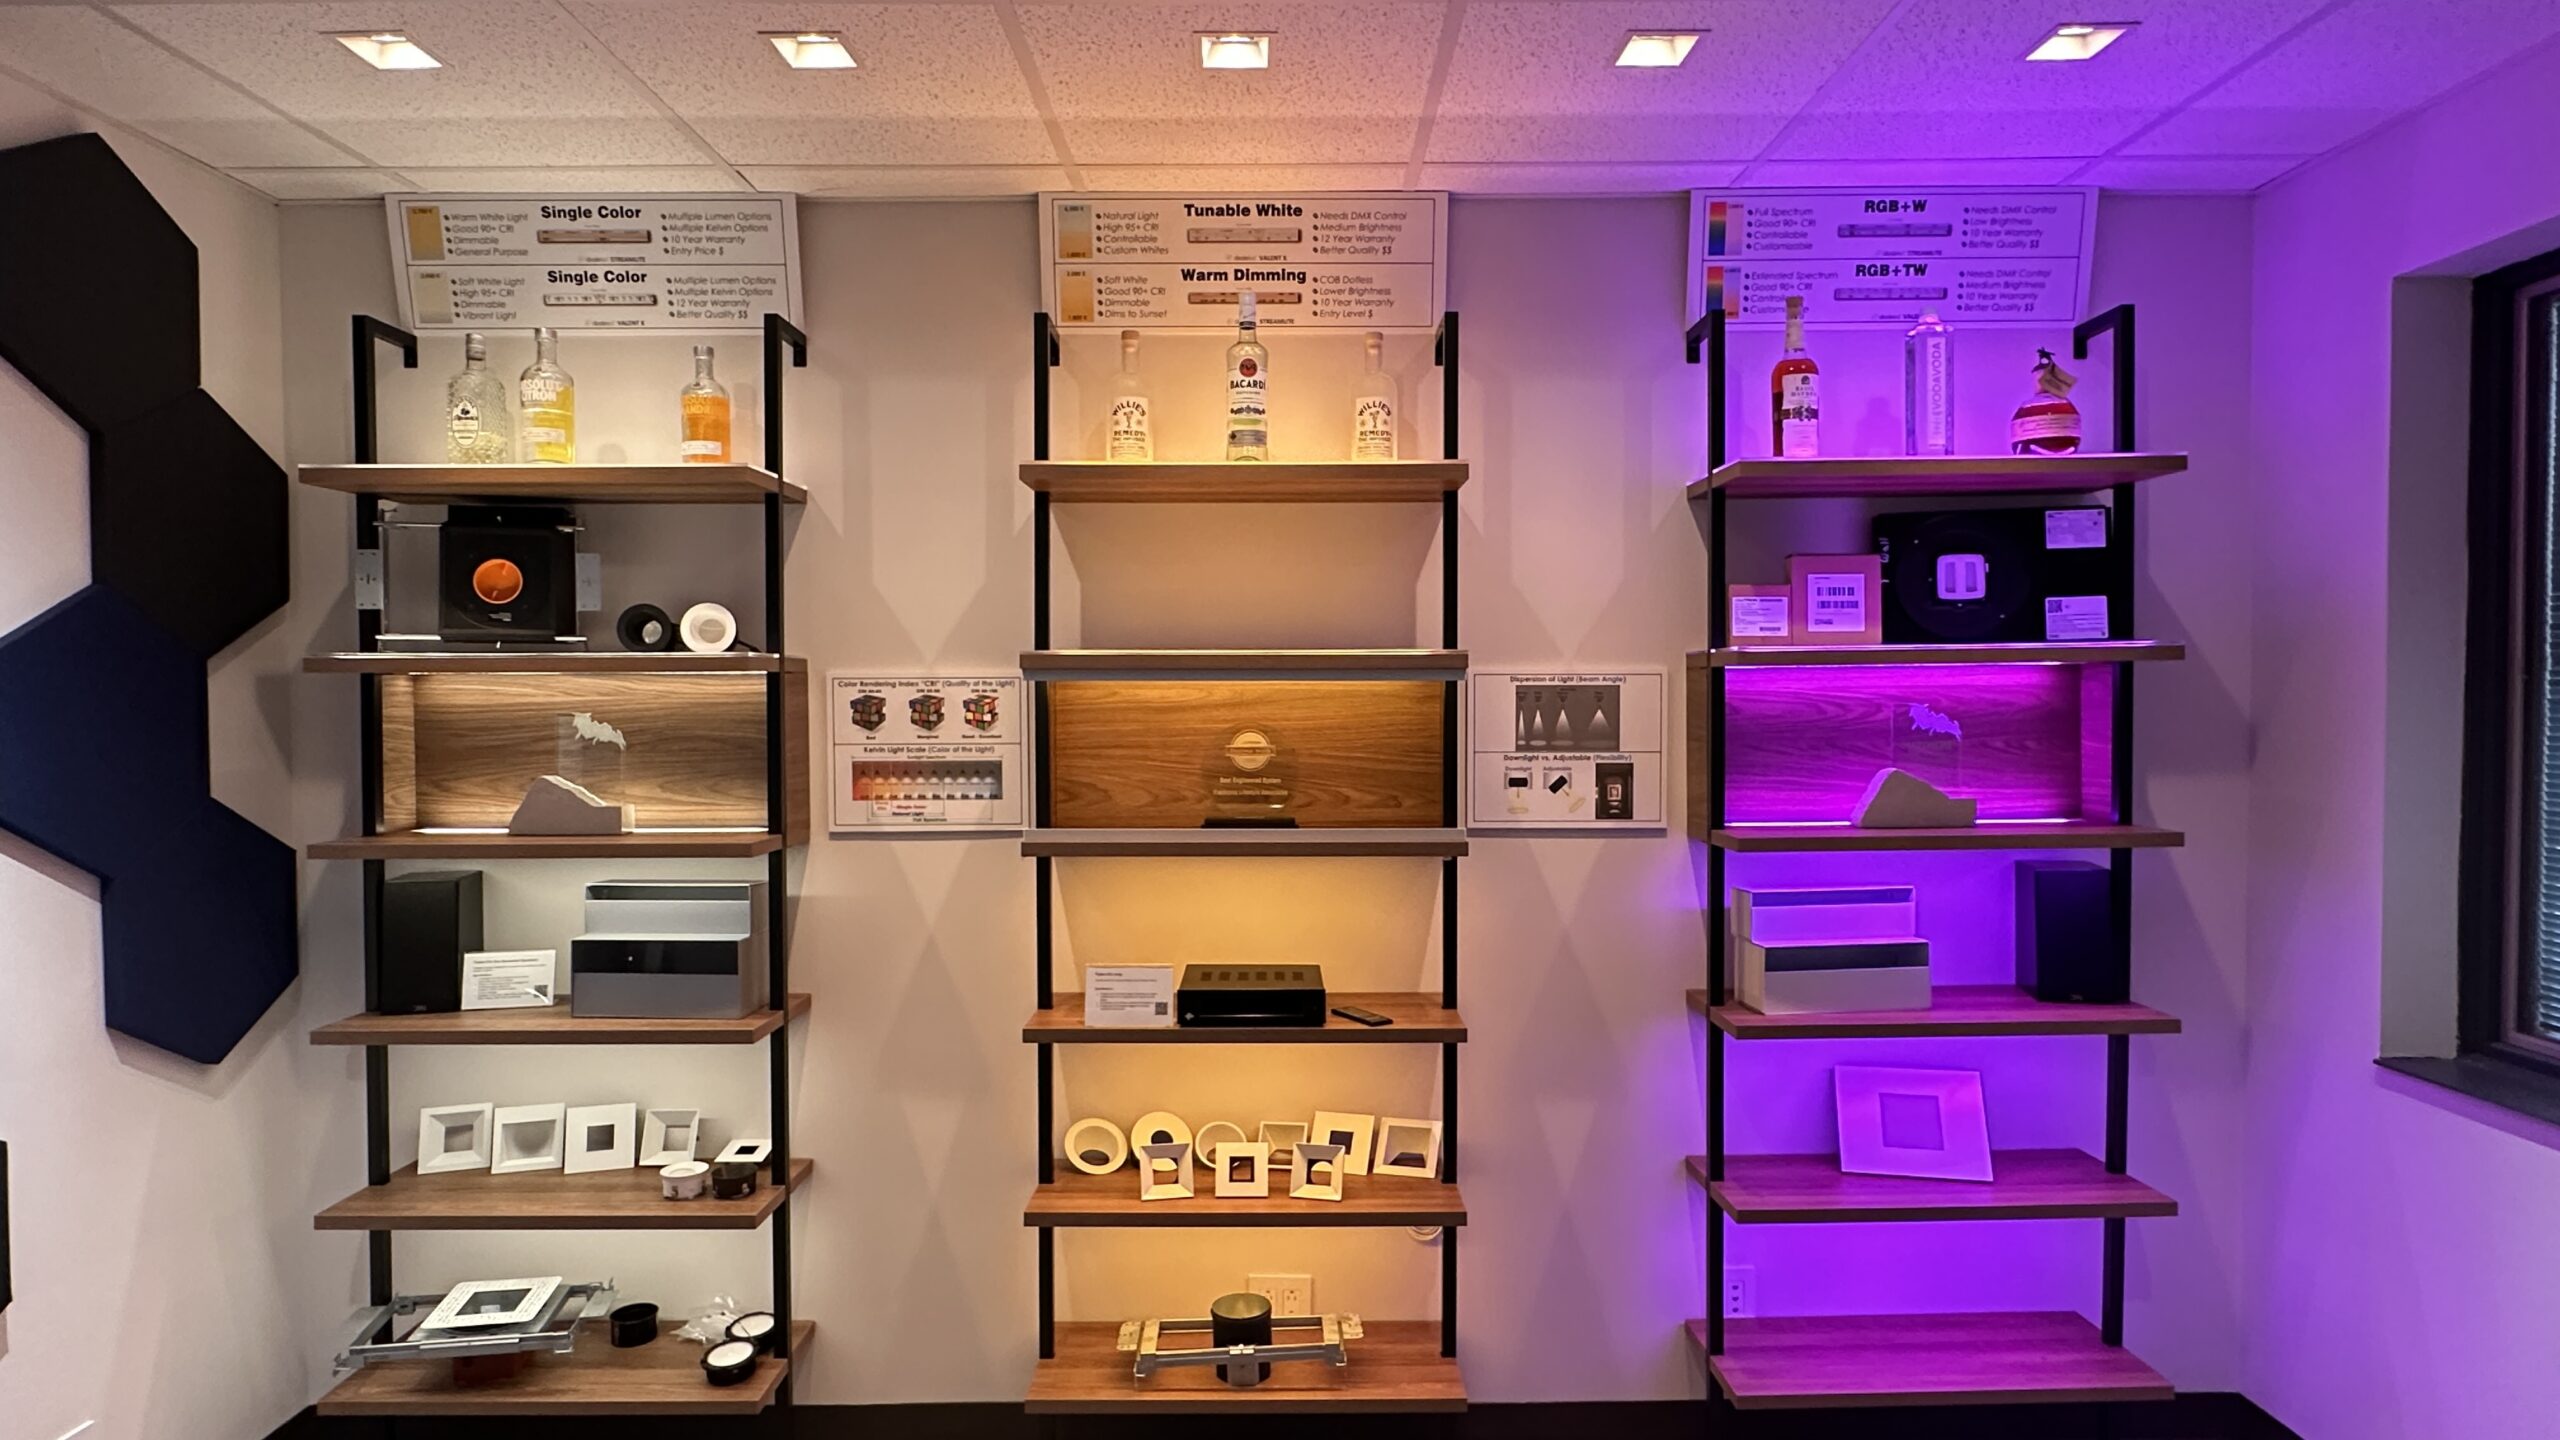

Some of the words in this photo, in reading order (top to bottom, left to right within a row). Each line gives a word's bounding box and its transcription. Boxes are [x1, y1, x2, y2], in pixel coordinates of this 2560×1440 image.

[1184, 204, 1251, 217] Tunable
[1256, 204, 1303, 217] White
[1864, 200, 1927, 213] RGB+W
[541, 206, 593, 221] Single
[598, 206, 642, 219] Color
[668, 212, 703, 222] Multiple
[705, 213, 734, 221] Lumen
[737, 212, 772, 222] Options
[1103, 212, 1136, 220] Natural
[1138, 212, 1159, 222] Light
[1320, 212, 1349, 220] Needs
[1351, 212, 1372, 220] DMX
[1374, 212, 1407, 220] Control
[1755, 208, 1769, 216] Full
[1771, 208, 1814, 217] Spectrum
[452, 214, 478, 222] Warm
[479, 214, 505, 222] White
[507, 213, 528, 223] Light
[452, 225, 478, 233] Good
[480, 225, 497, 233] 90+
[499, 225, 514, 233] CRI
[669, 224, 703, 233] Multiple
[706, 224, 732, 232] Kelvin
[734, 224, 768, 233] Options
[1103, 223, 1124, 233] High
[1320, 223, 1356, 231] Medium
[1358, 223, 1402, 233] Brightness
[1103, 235, 1158, 243] Controllable
[1754, 230, 1808, 239] Controllable
[453, 236, 499, 245] Dimmable
[671, 235, 680, 244] 10
[682, 235, 703, 243] Year
[706, 235, 745, 245] Warranty
[1321, 235, 1331, 243] 12
[1333, 235, 1353, 243] Year
[1355, 235, 1396, 245] Warranty
[1968, 240, 1995, 249] Better
[1997, 240, 2027, 250] Quality
[2029, 239, 2040, 249] $$
[455, 248, 491, 256] General
[493, 248, 528, 258] Purpose
[671, 247, 692, 257] Entry
[694, 246, 716, 255] Price
[718, 246, 724, 256] $
[1103, 246, 1137, 255] Custom
[1140, 246, 1169, 255] Whites
[1320, 246, 1346, 254] Better
[1348, 246, 1380, 256] Quality
[1382, 245, 1392, 256] $$
[1855, 264, 1928, 277] RGB+TW
[547, 271, 599, 286] Single
[604, 270, 647, 283] Color
[674, 276, 708, 286] Multiple
[710, 277, 739, 285] Lumen
[742, 276, 776, 286] Options
[1104, 276, 1121, 285] Soft
[1123, 276, 1148, 285] White
[1181, 269, 1228, 281] Warm
[1234, 268, 1307, 284] Dimming
[1320, 276, 1340, 284] COB
[1343, 276, 1373, 284] Dotless
[458, 278, 474, 286] Soft
[477, 278, 502, 286] White
[504, 277, 525, 287] Light
[460, 289, 479, 299] High
[481, 290, 497, 298] 95+
[499, 290, 514, 298] CRI
[675, 288, 709, 297] Multiple
[711, 288, 737, 296] Kelvin
[739, 288, 773, 297] Options
[1104, 288, 1130, 296] Good
[1132, 288, 1148, 296] 90+
[1150, 288, 1166, 296] CRI
[1320, 287, 1344, 296] Lower
[1346, 287, 1391, 297] Brightness
[461, 300, 506, 309] Dimmable
[676, 299, 685, 308] 12
[688, 299, 709, 307] Year
[711, 299, 750, 309] Warranty
[1104, 299, 1150, 307] Dimmable
[1320, 299, 1330, 307] 10
[1332, 299, 1352, 307] Year
[1354, 299, 1394, 309] Warranty
[1964, 303, 1990, 312] Better
[1992, 303, 2023, 313] Quality
[2024, 303, 2035, 312] $$
[462, 311, 493, 320] Vibrant
[496, 311, 517, 321] Light
[677, 310, 702, 319] Better
[704, 310, 736, 320] Quality
[738, 310, 748, 320] $$
[1104, 310, 1126, 318] Dims
[1128, 310, 1137, 318] to
[1139, 310, 1167, 318] Sunset
[1320, 309, 1341, 320] Entry
[1343, 309, 1366, 318] Level
[1368, 309, 1374, 319] $
